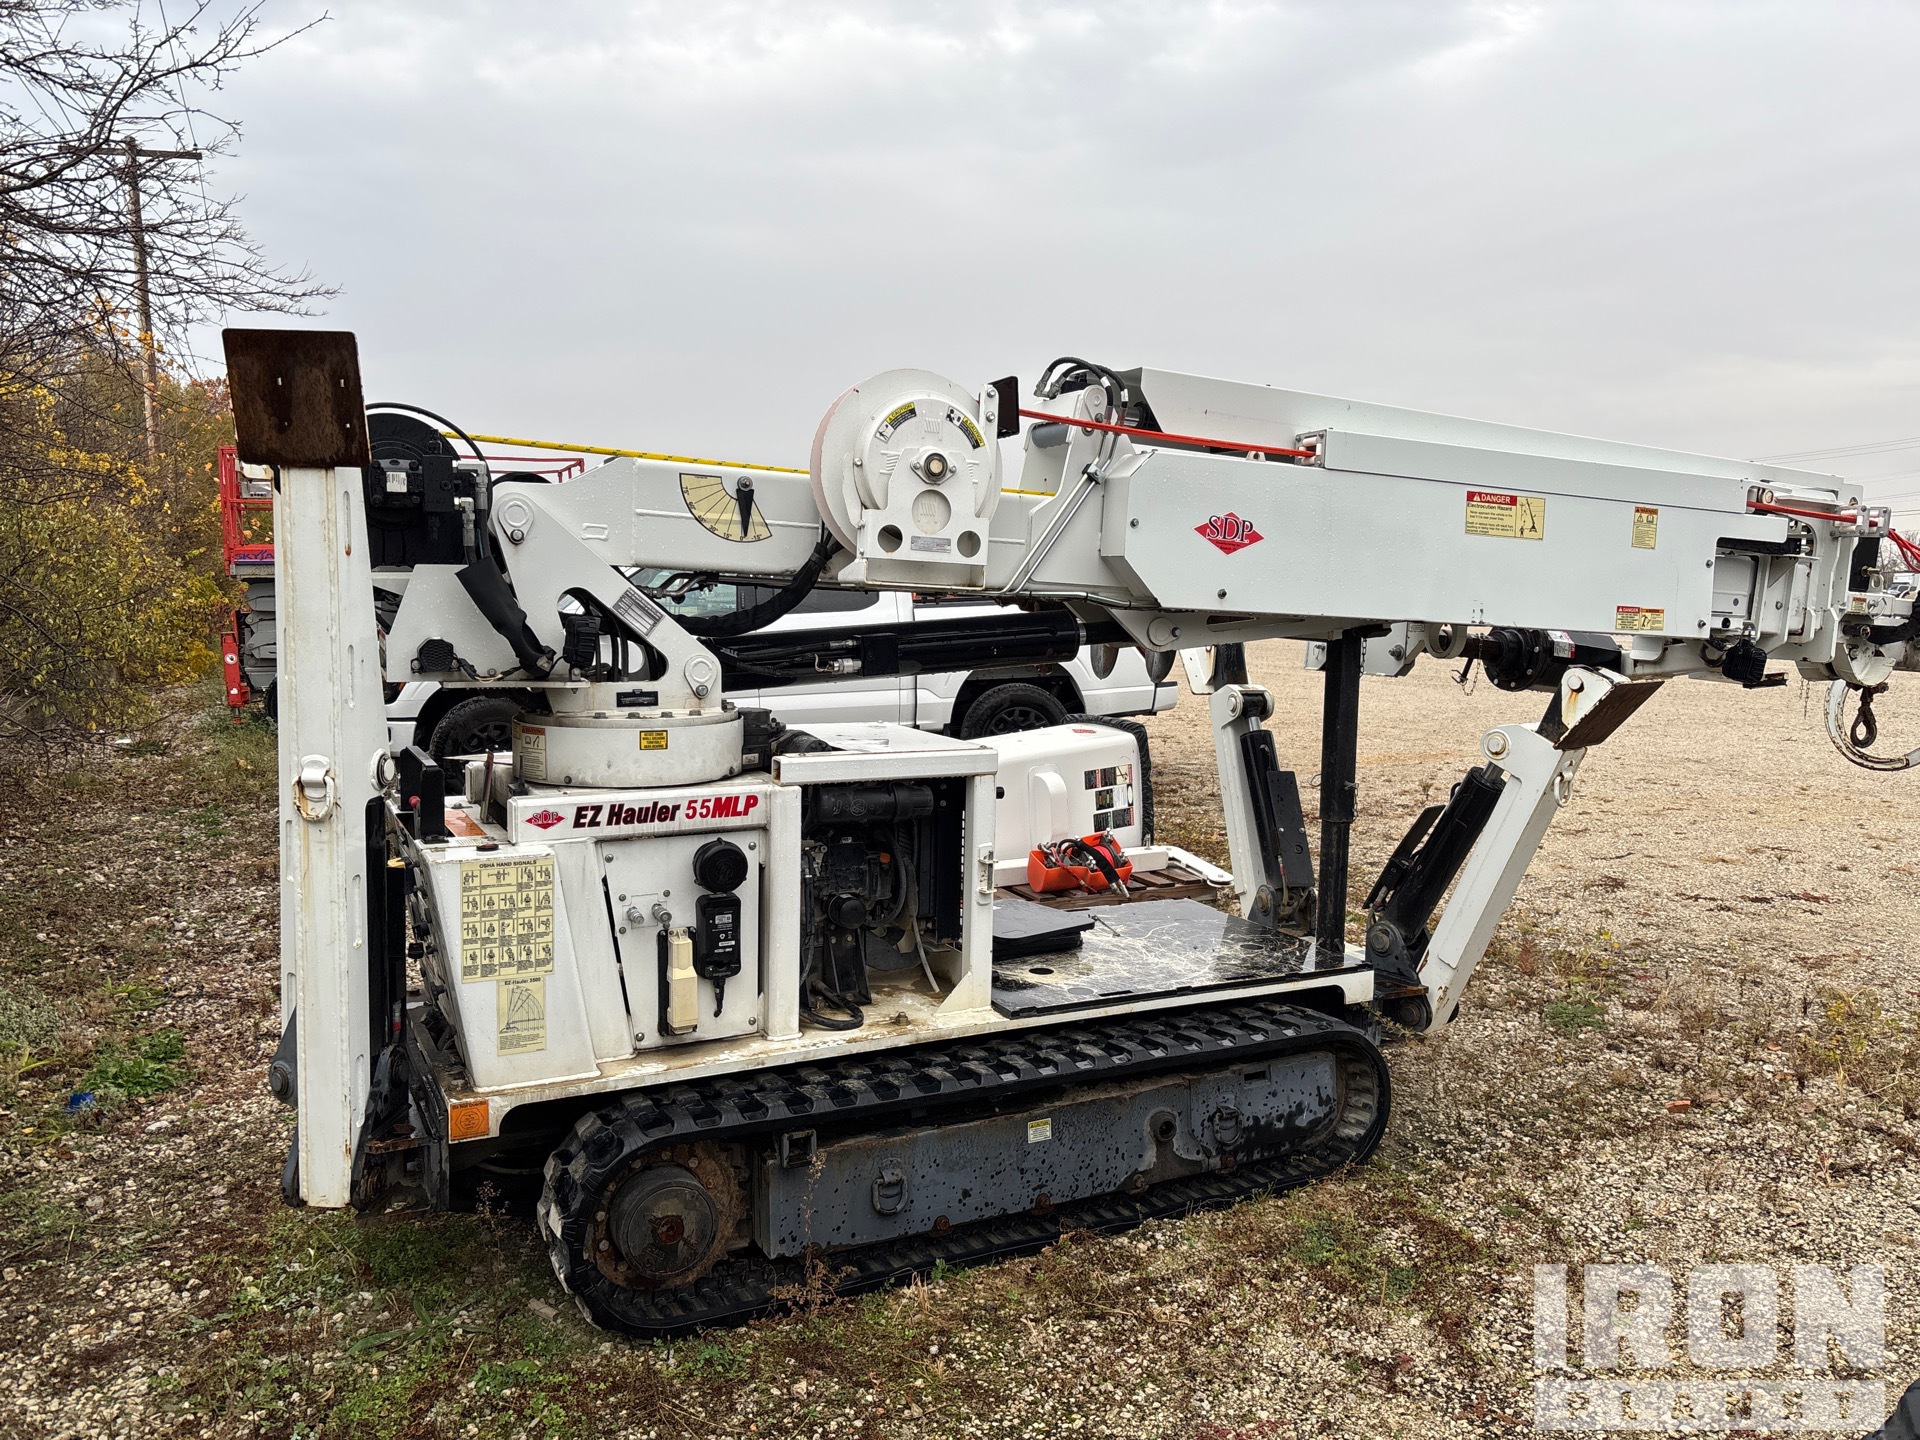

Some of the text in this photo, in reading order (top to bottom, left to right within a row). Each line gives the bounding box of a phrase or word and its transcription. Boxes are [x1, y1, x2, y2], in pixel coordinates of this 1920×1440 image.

[891, 403, 913, 418] CAUTION
[967, 420, 984, 445] CAUTION
[1481, 493, 1511, 504] DANGER
[573, 804, 604, 829] EZ
[606, 801, 682, 826] Hauler
[685, 795, 759, 820] 55MLP
